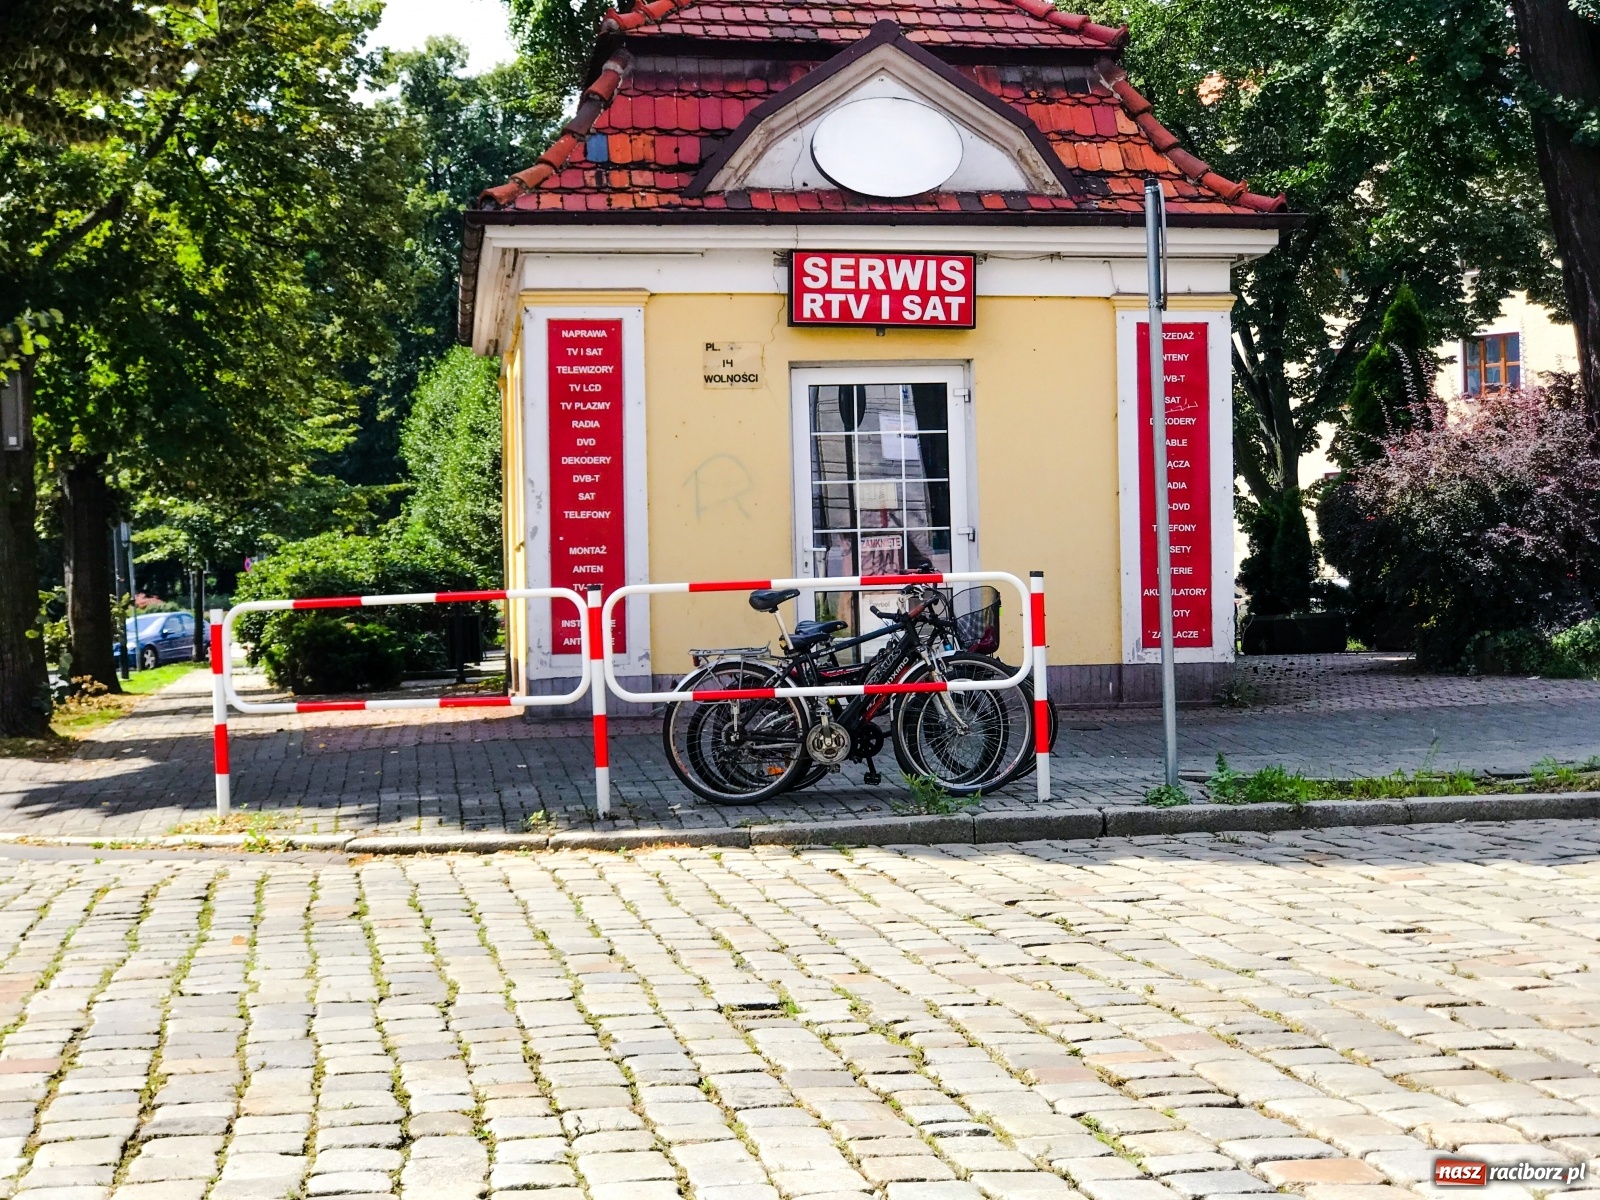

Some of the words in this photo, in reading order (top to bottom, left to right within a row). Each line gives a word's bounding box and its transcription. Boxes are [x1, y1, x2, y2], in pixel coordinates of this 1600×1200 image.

[803, 256, 966, 292] SERWIS
[803, 293, 870, 319] RTV
[881, 295, 890, 319] I
[902, 295, 966, 321] SAT
[561, 329, 608, 338] NAPRAWA
[1162, 330, 1195, 340] RZEDAŻ
[705, 342, 721, 351] PL.
[566, 347, 579, 356] TV
[580, 347, 584, 356] I
[585, 347, 604, 356] SAT
[1162, 353, 1189, 361] NTENY
[722, 359, 733, 368] 14
[556, 365, 614, 374] TELEWIZORY
[703, 371, 759, 383] WOLNOŚCI
[568, 383, 581, 392] TV
[583, 383, 602, 392] LCD
[1164, 396, 1181, 404] SAT
[560, 402, 573, 410] TV
[574, 402, 611, 410] PLAZMY
[572, 420, 600, 428] RADIA
[1149, 417, 1197, 426] DKODERY
[576, 438, 596, 446] DVD
[1165, 439, 1188, 447] ABLE
[561, 456, 611, 465] DEKODERY
[1166, 460, 1190, 469] ĄCZA
[573, 474, 600, 483] DVB-T
[1167, 481, 1187, 489] ADIA
[578, 492, 596, 501] SAT
[1167, 502, 1190, 511] -DVD
[563, 510, 611, 519] TELEFONY
[1151, 524, 1197, 532] TEFONY
[569, 544, 607, 555] MONTAŻ
[1169, 545, 1192, 554] SETY
[572, 565, 604, 573] ANTEN
[1156, 566, 1193, 575] TERIE
[1143, 588, 1208, 596] AKULATORY
[1151, 630, 1199, 639] ZACZE
